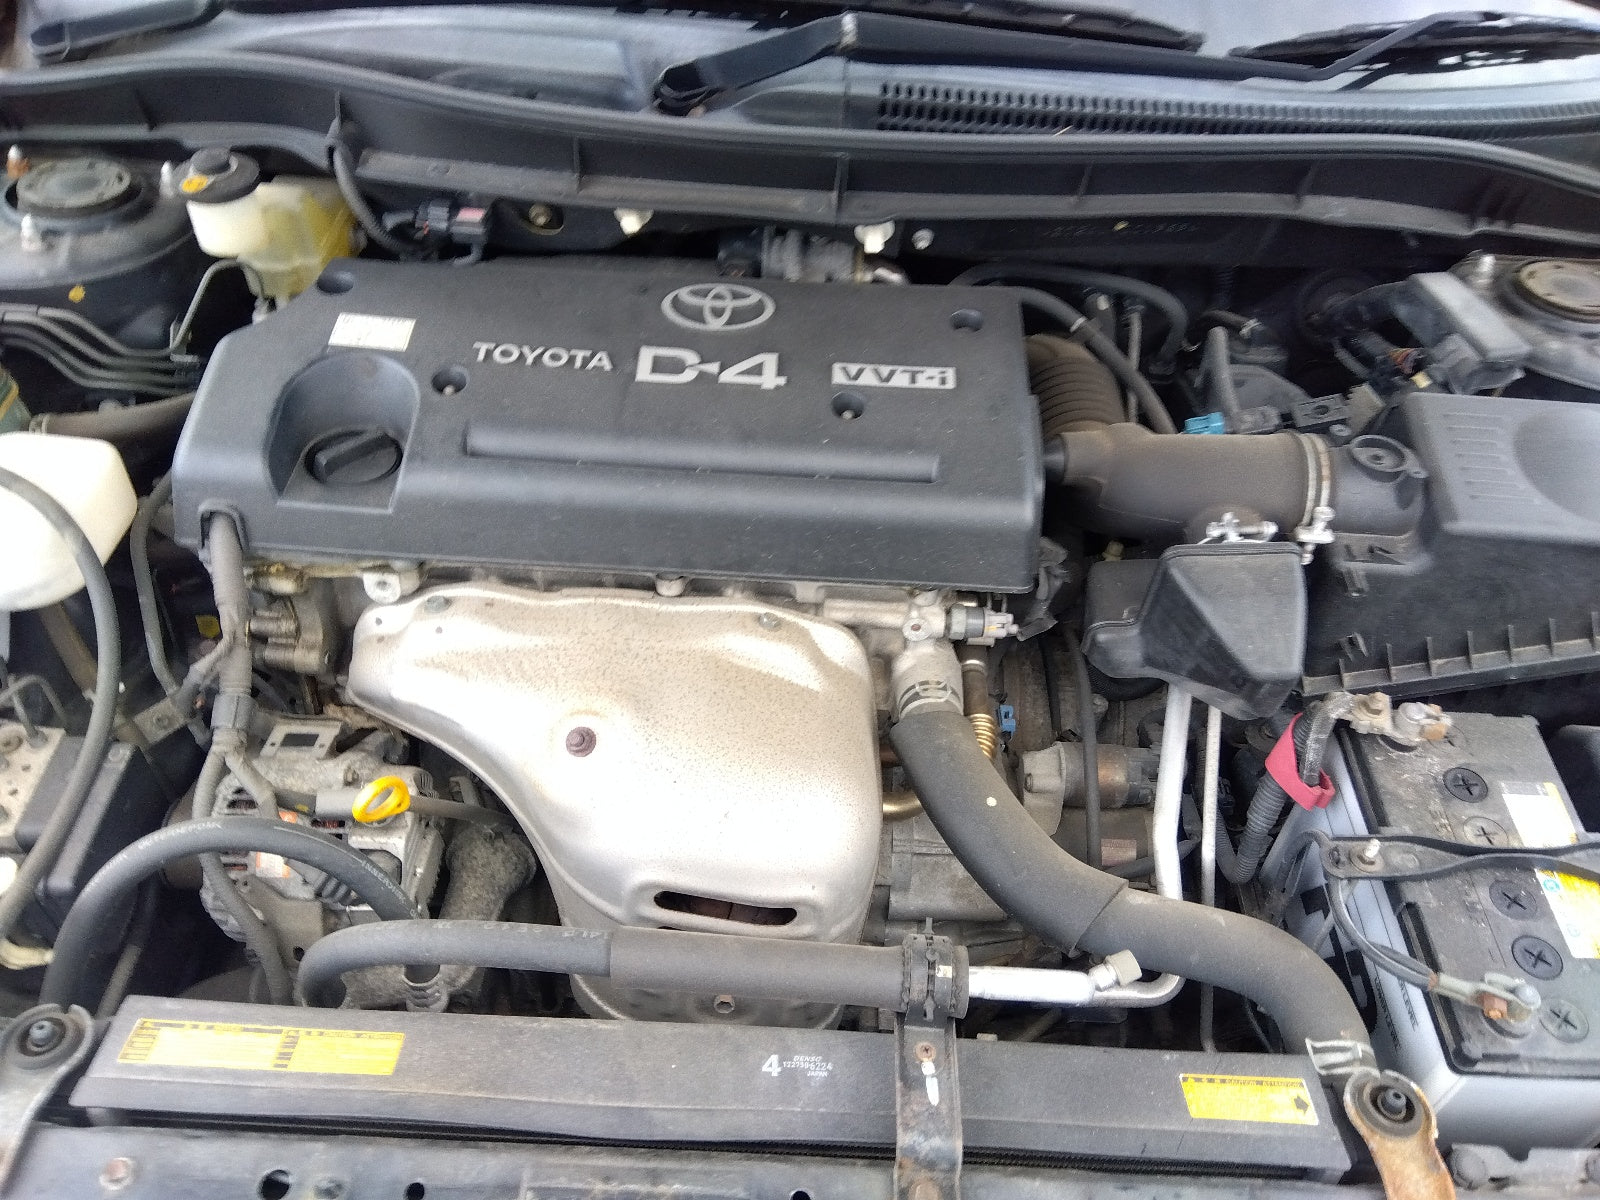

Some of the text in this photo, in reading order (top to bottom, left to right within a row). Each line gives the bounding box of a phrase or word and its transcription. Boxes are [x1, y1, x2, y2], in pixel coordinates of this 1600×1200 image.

[472, 341, 949, 390] TOYOTA D-4 VVT-i
[761, 1054, 782, 1077] 4
[793, 1055, 823, 1063] DENSO
[806, 1070, 829, 1078] JAPAN
